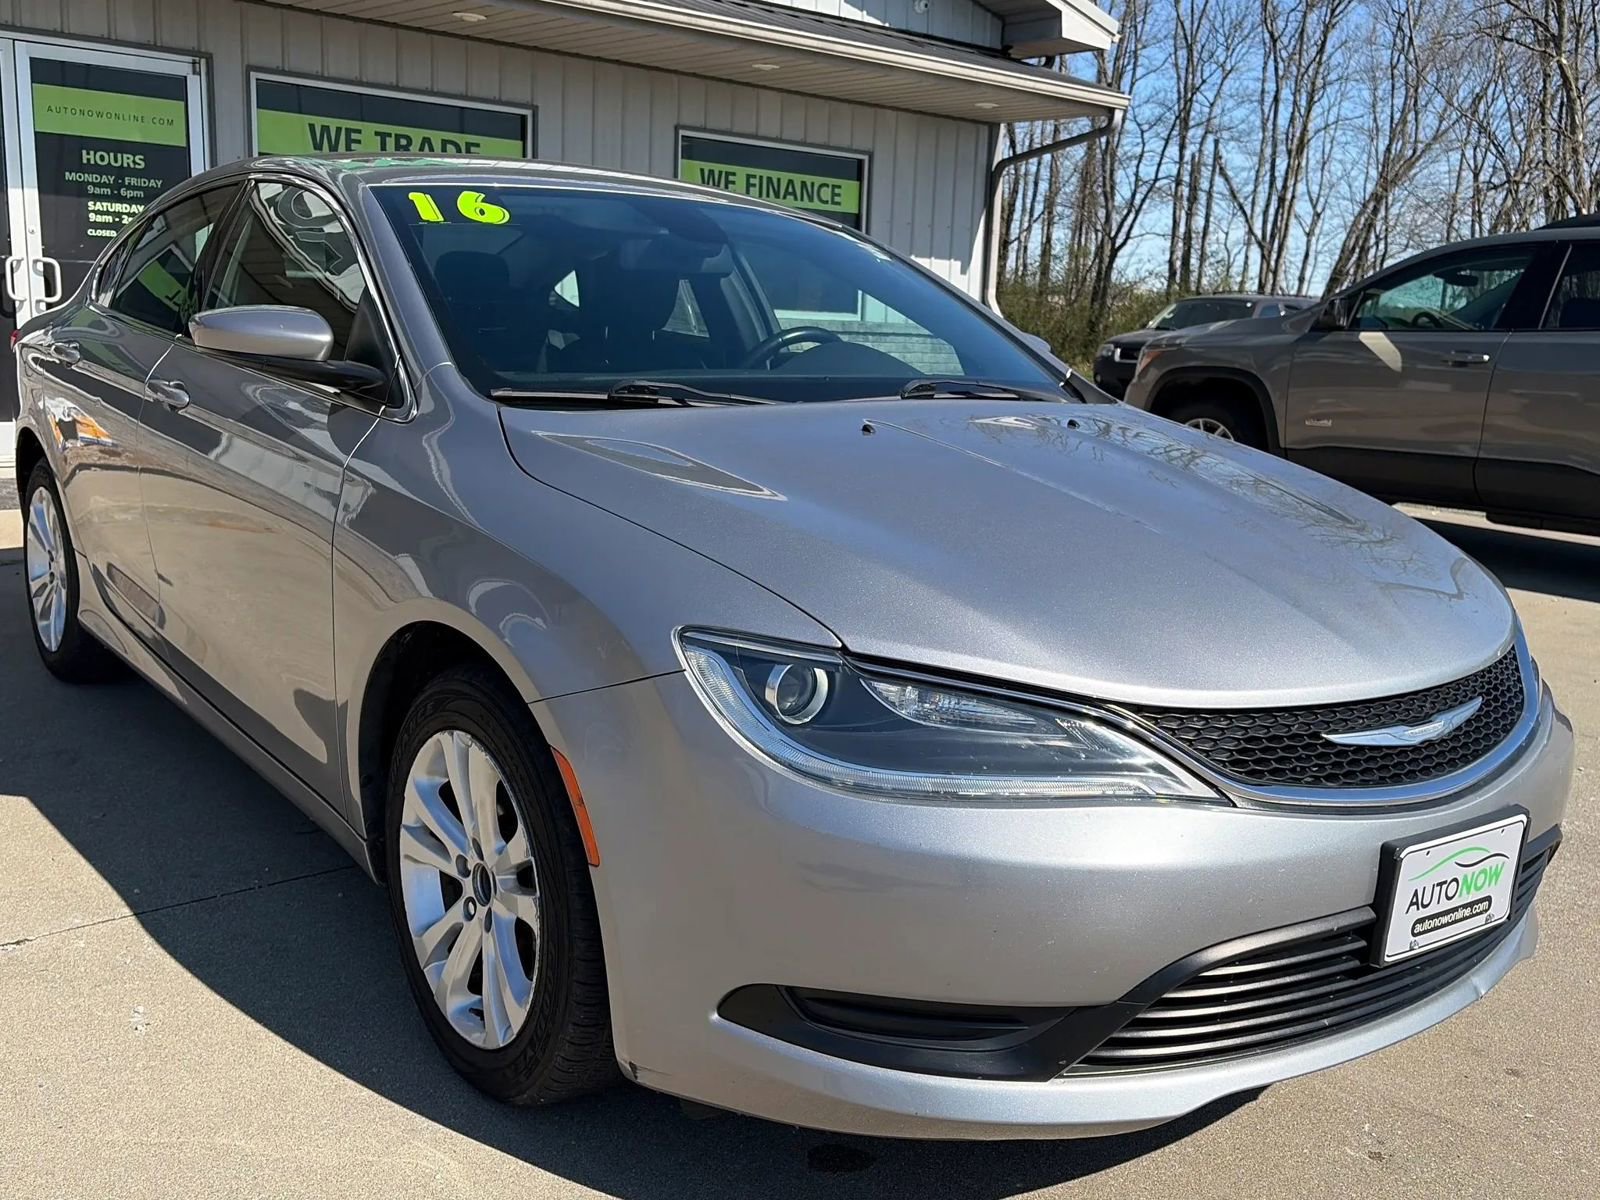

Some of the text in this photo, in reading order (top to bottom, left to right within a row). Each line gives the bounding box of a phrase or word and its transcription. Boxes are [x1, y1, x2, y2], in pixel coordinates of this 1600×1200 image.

[308, 123, 362, 153] WE
[82, 150, 145, 168] HOURS
[65, 171, 115, 184] MONDAY
[124, 177, 163, 188] FRIDAY
[699, 167, 842, 206] WE FINANCE
[87, 184, 111, 195] 9am
[120, 187, 144, 199] 6pm
[87, 201, 144, 213] SATURDAY
[88, 212, 113, 223] 9am
[87, 228, 117, 238] CLOSED
[1413, 900, 1489, 934] autonowonline.com
